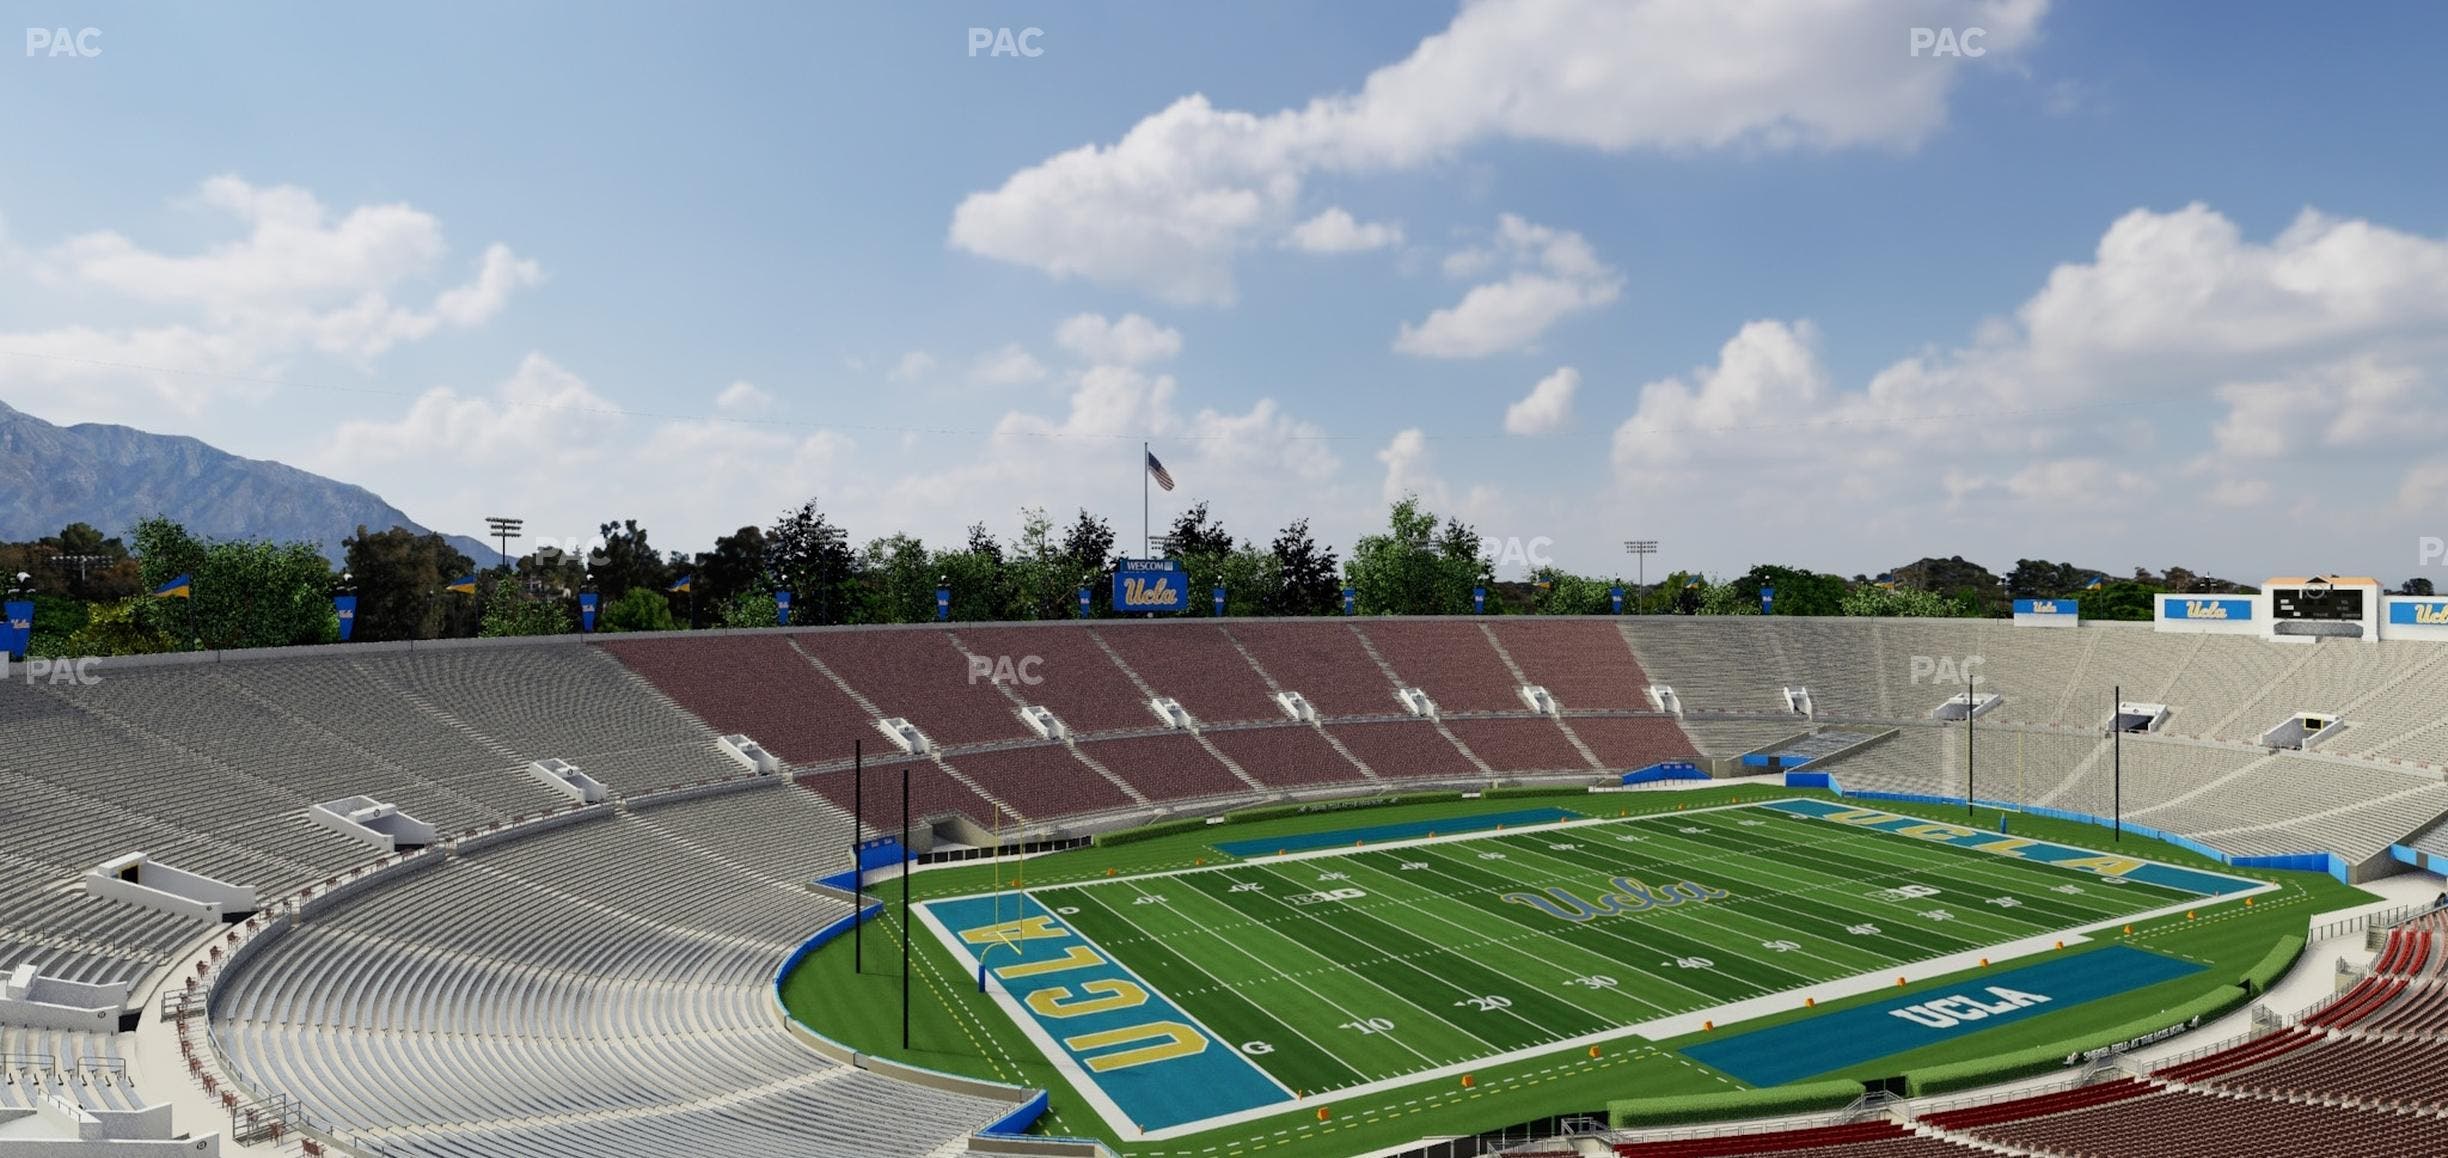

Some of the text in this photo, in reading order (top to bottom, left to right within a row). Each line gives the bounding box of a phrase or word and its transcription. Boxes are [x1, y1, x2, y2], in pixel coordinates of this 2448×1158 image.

[1126, 561, 1163, 571] WESCOM
[1124, 578, 1178, 605] Ucla
[2186, 600, 2228, 619] Ucla
[1823, 810, 2147, 877] UCLA
[1500, 876, 1729, 923] Ucla
[1761, 938, 1802, 953] 50
[1674, 955, 1715, 971] 40
[1573, 974, 1619, 990] 30
[958, 914, 1210, 1073] UCLA
[1466, 994, 1513, 1012] 20
[1888, 986, 2053, 1029] UCLA
[1349, 1017, 1395, 1035] 10
[1241, 1040, 1275, 1056] G
